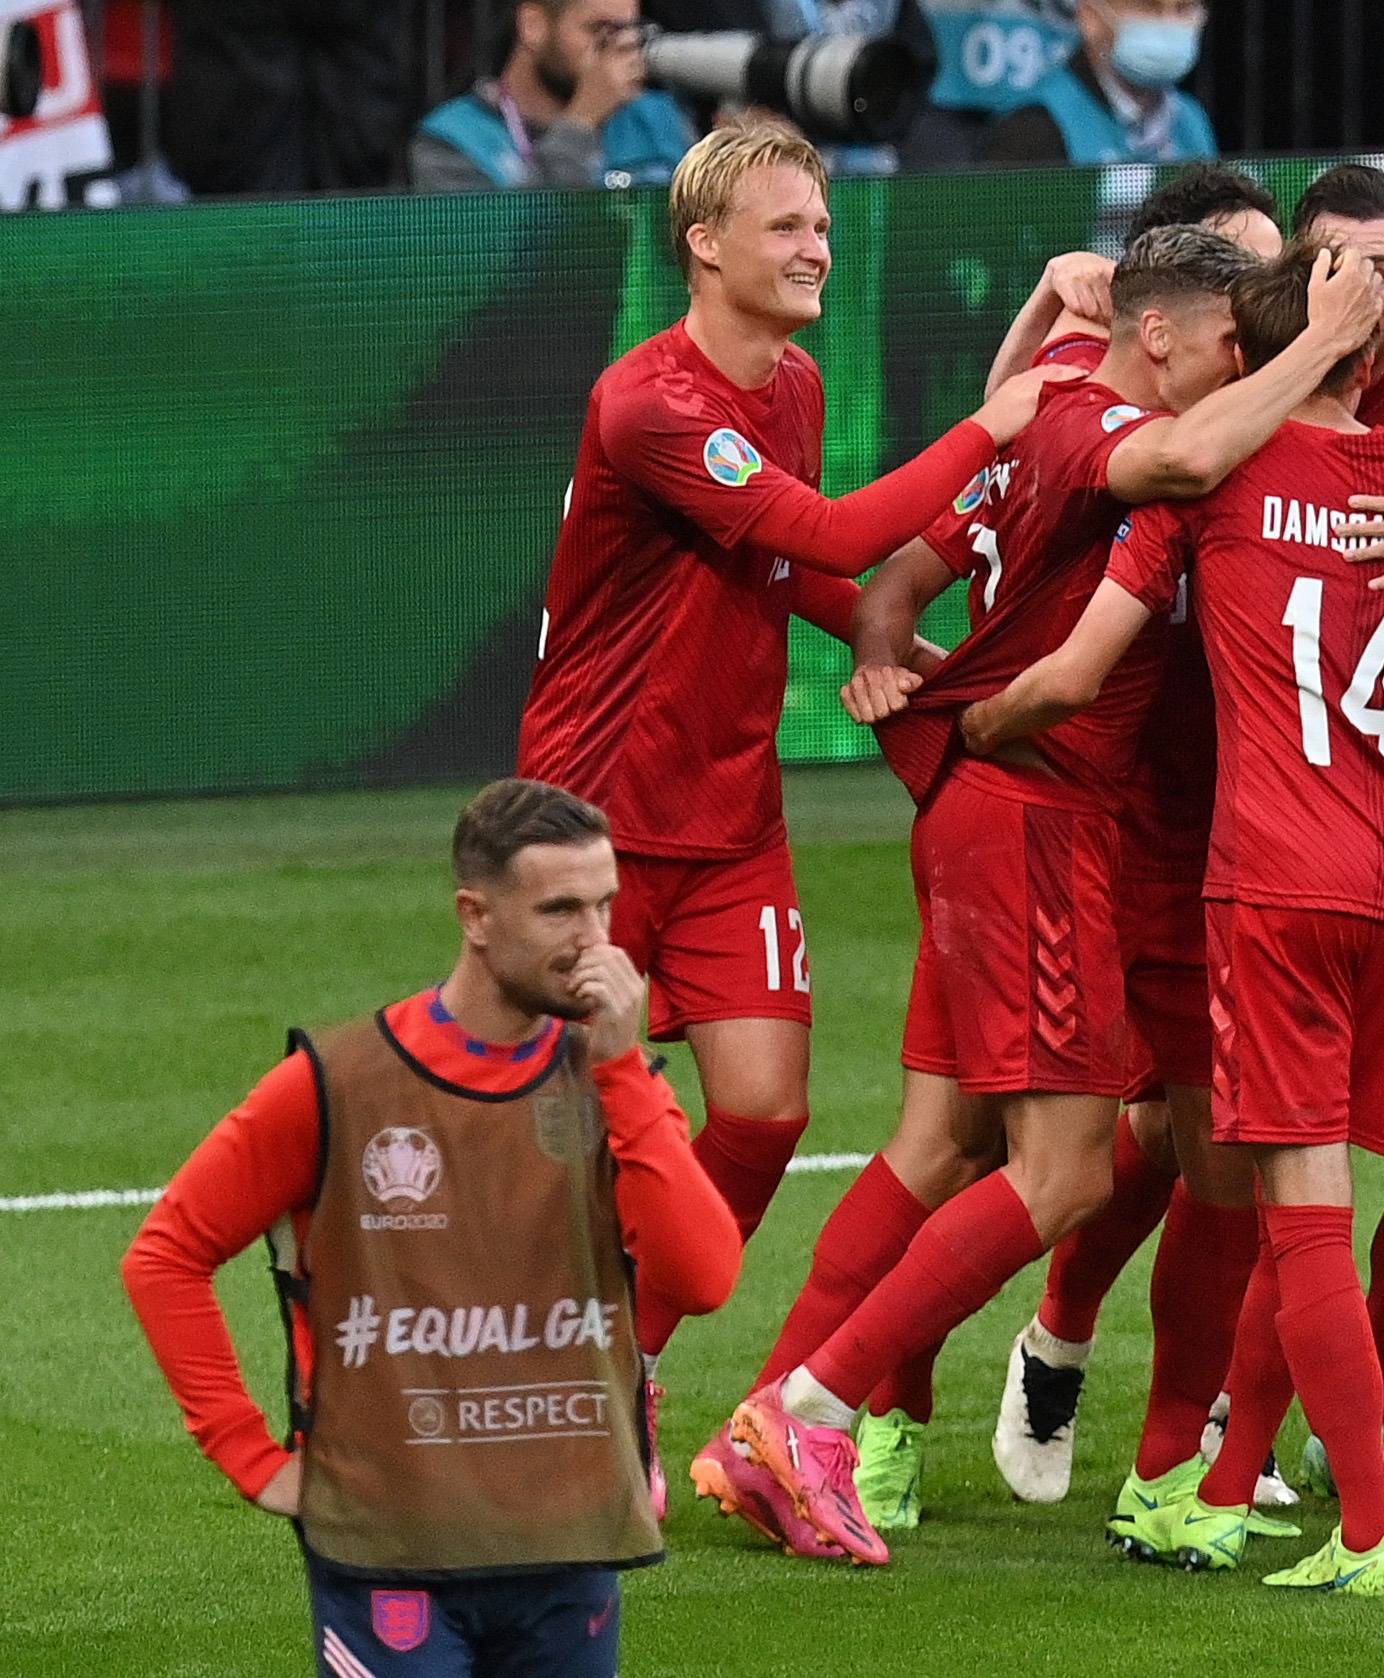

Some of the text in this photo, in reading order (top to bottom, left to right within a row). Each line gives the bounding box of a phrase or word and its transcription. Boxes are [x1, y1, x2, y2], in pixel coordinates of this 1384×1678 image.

[760, 906, 810, 993] 12
[336, 1295, 539, 1368] #EQUAL
[459, 1392, 609, 1431] RESPECT
